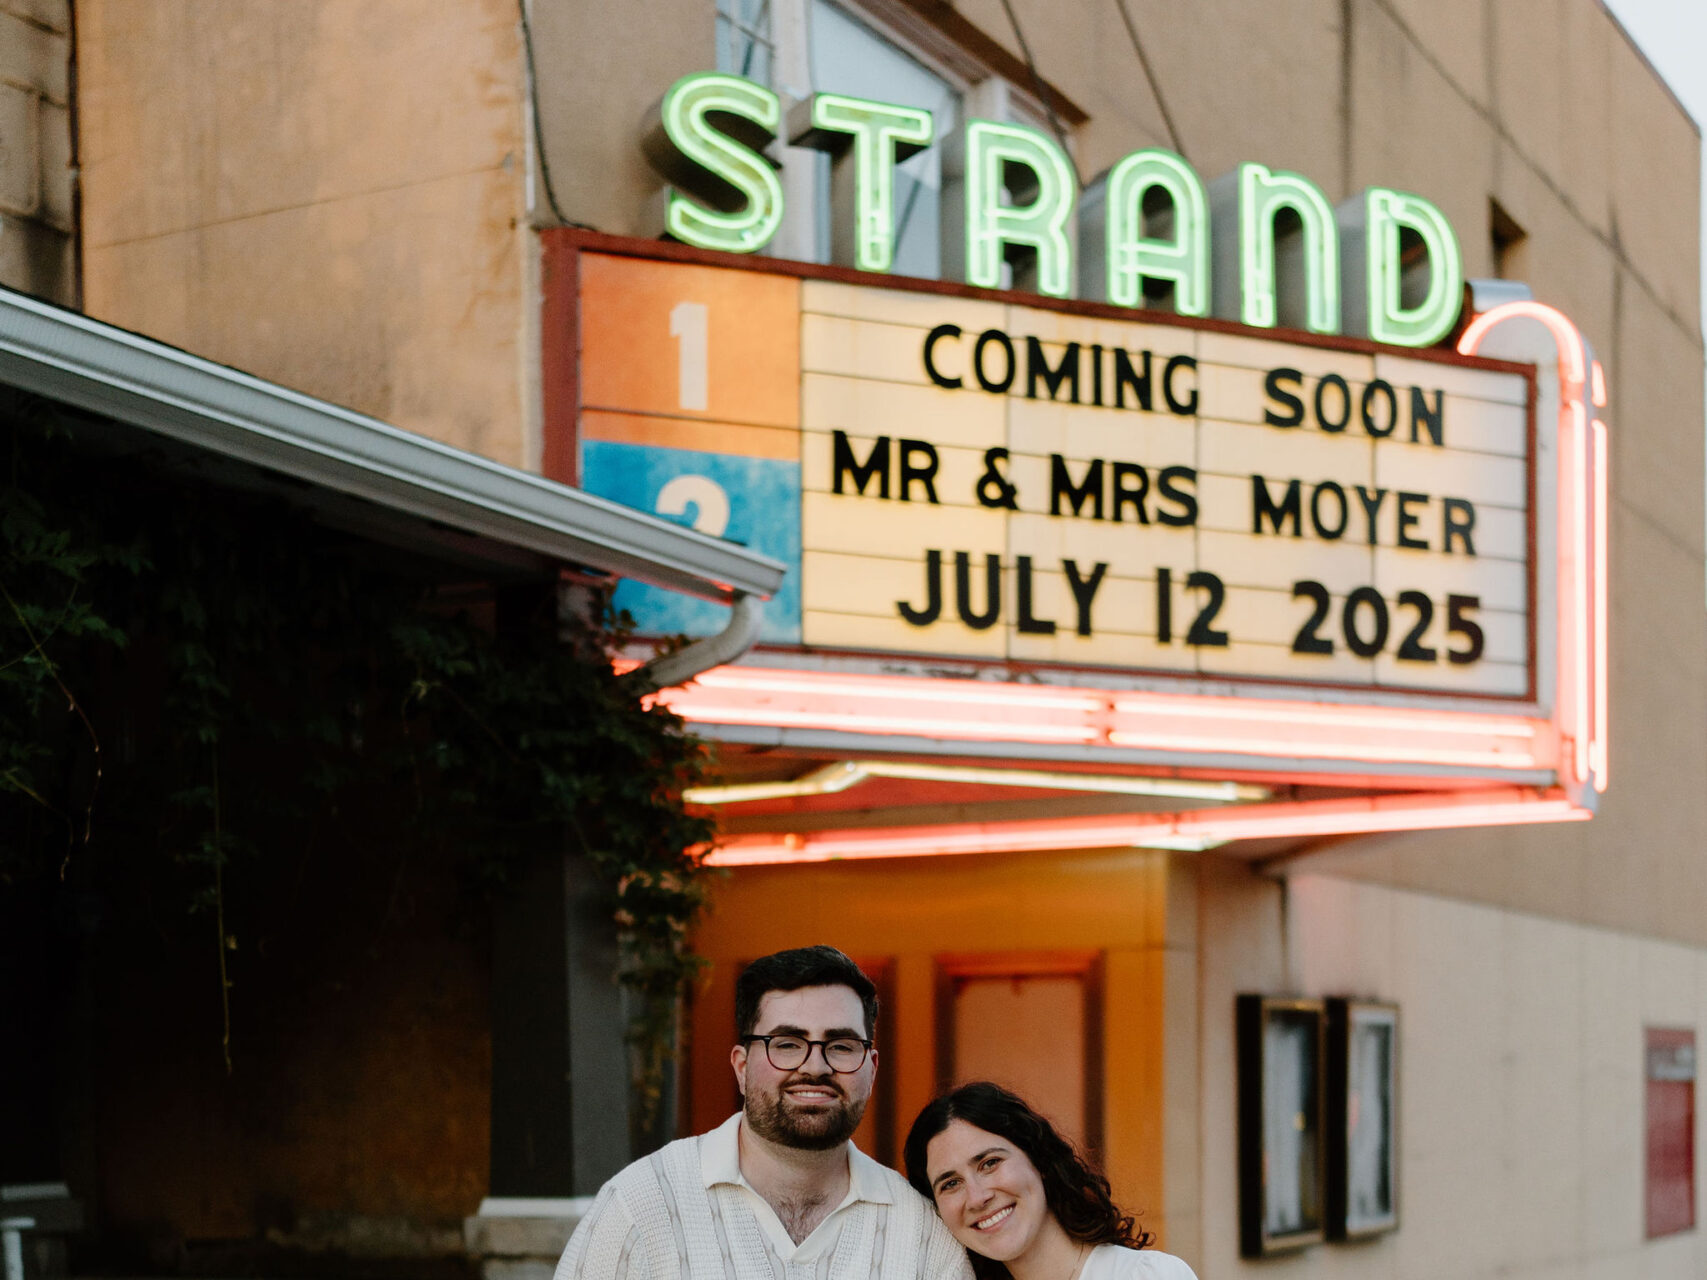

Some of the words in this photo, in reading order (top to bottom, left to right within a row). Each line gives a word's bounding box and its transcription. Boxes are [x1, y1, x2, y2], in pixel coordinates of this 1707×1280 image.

[662, 71, 1463, 347] STRAND
[669, 301, 709, 411] 1
[922, 322, 1201, 418] COMING
[1262, 365, 1446, 448] SOON
[831, 428, 942, 506] MR
[975, 445, 1021, 512] &
[1048, 452, 1201, 529] MRS
[1251, 473, 1478, 557] MOYER
[896, 548, 1110, 638] JULY
[1155, 566, 1231, 648] 12
[1290, 579, 1487, 666] 2025
